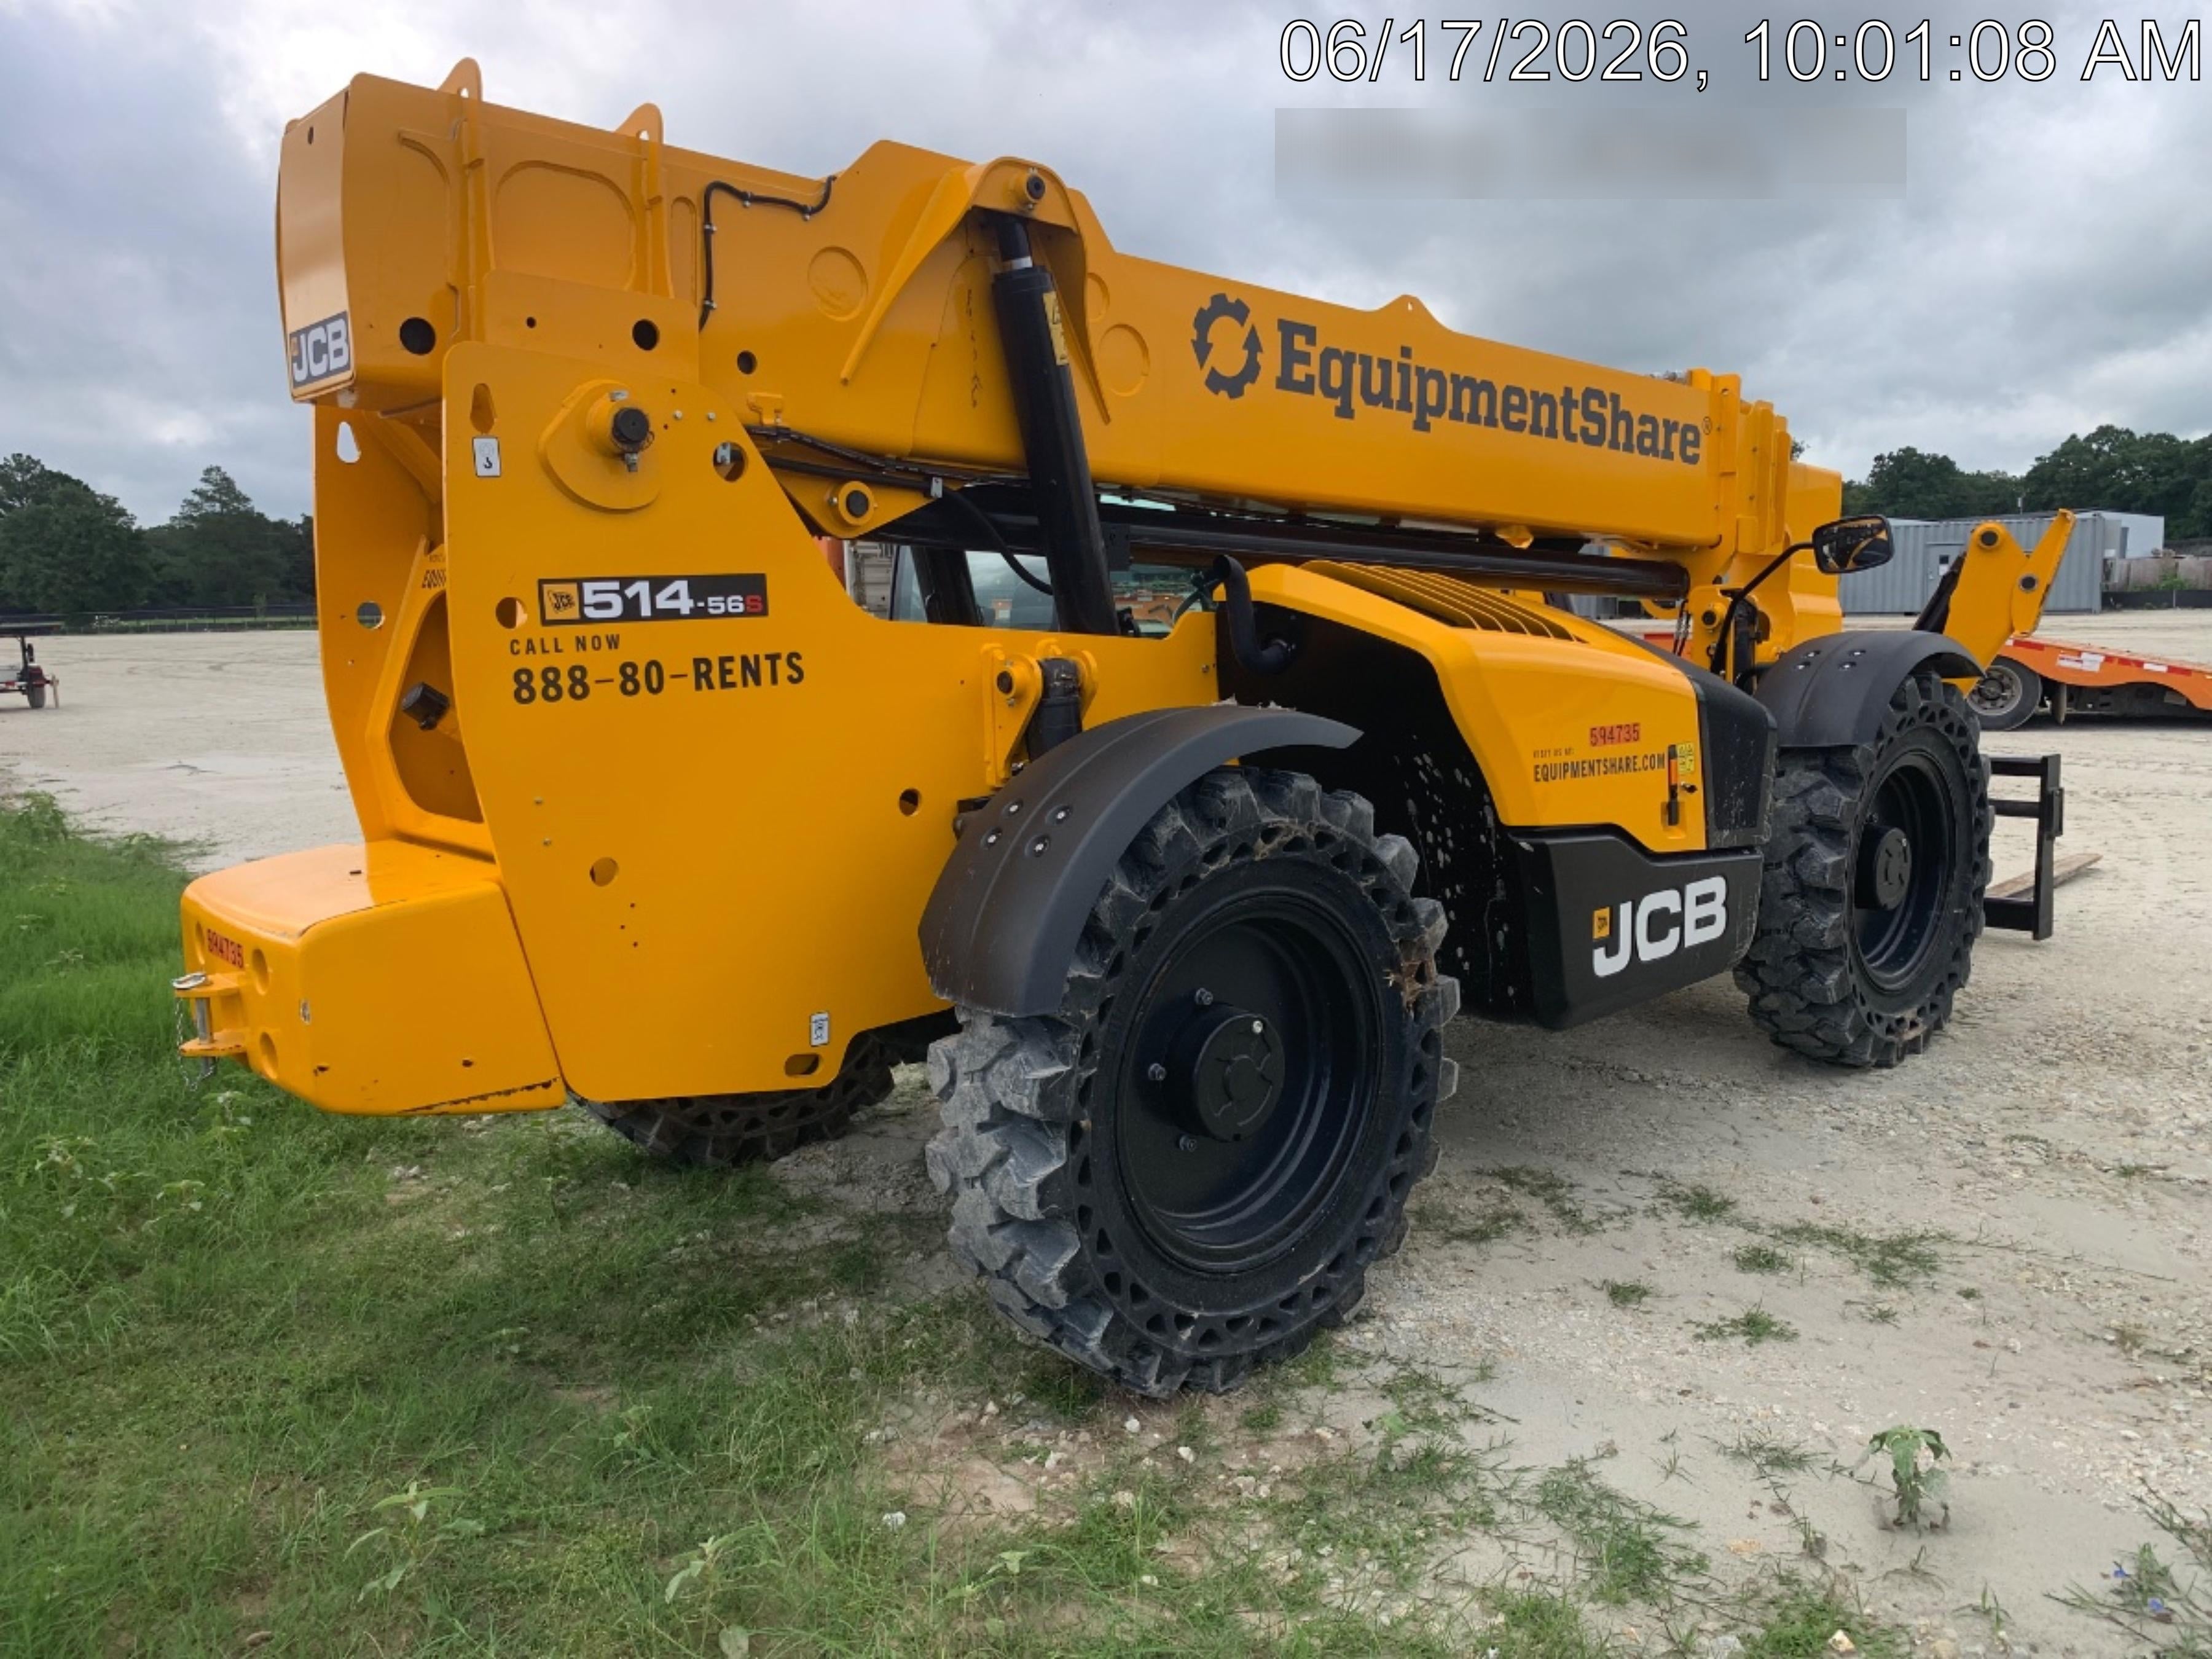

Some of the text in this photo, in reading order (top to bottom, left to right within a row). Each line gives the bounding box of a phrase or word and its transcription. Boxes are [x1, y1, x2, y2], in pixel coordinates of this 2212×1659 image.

[292, 318, 349, 382] JCB
[510, 633, 621, 655] CALL NOW
[512, 651, 805, 705] 888-80-RENTS
[1590, 723, 1640, 747] 594735
[1534, 753, 1665, 782] EQUIPMENTSHARE.COM
[1593, 875, 1727, 978] JCB
